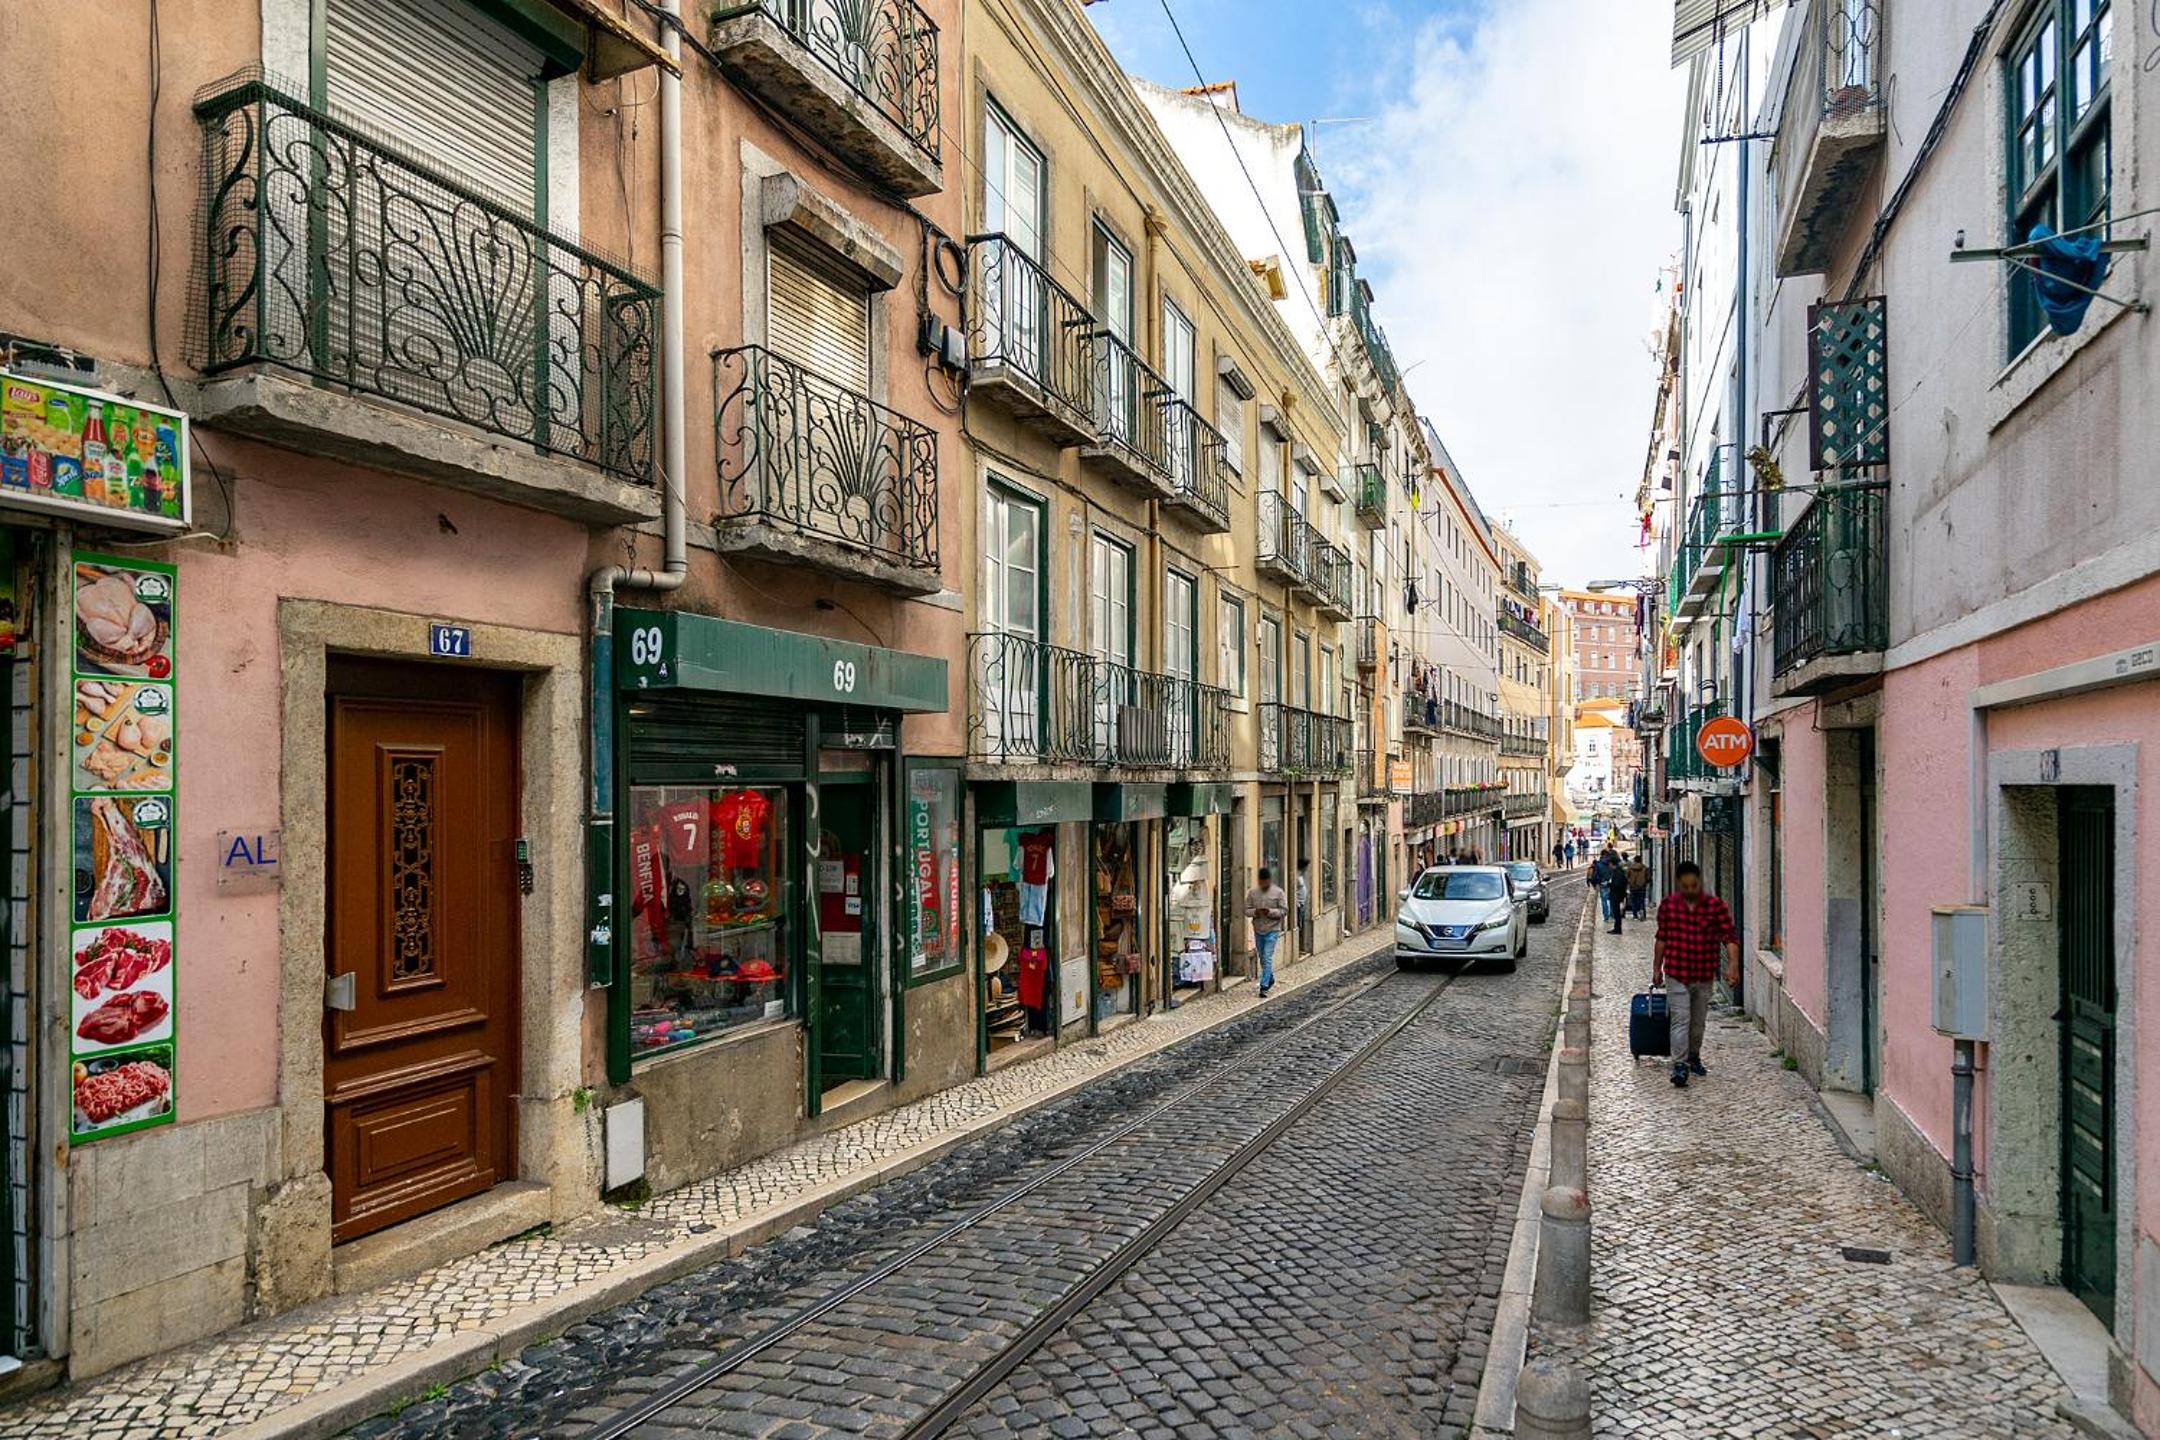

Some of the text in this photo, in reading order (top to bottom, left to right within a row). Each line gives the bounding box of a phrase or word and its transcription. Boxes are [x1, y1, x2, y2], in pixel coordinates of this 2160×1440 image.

[439, 628, 463, 653] 67
[632, 627, 663, 665] 69
[834, 660, 856, 693] 69
[1703, 733, 1748, 750] ATM
[225, 836, 277, 867] AL
[683, 823, 697, 850] 7
[916, 800, 932, 903] PORTUGAL
[636, 842, 654, 904] BENFICA
[951, 847, 959, 931] PRTUGAL
